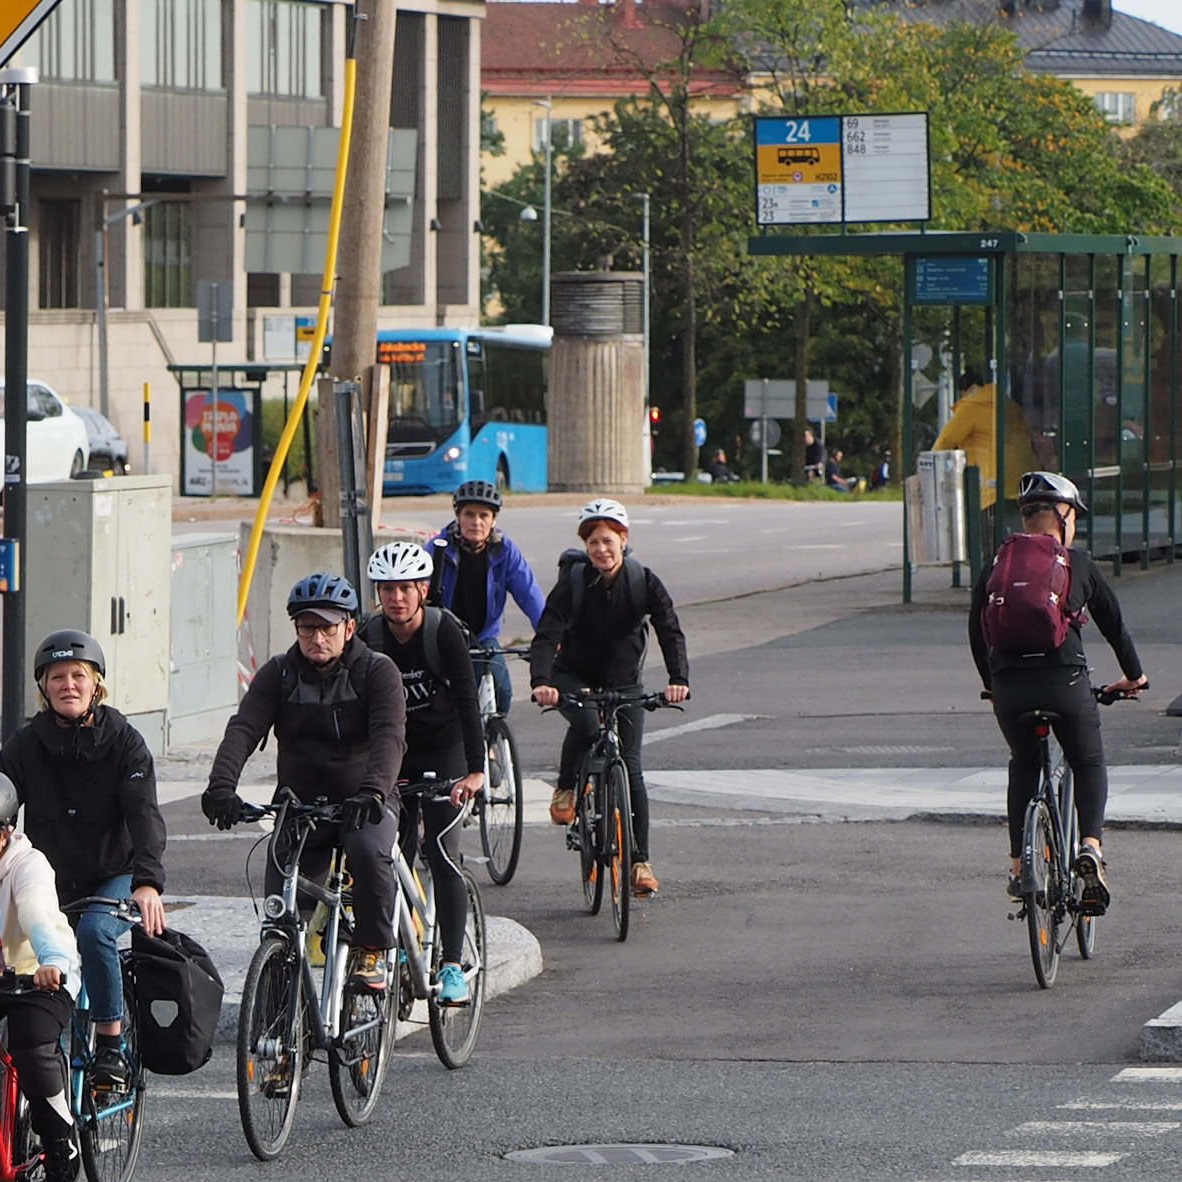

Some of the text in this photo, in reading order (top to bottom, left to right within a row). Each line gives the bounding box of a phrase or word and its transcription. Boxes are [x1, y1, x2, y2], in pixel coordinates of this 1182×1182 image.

[846, 117, 859, 129] 69
[785, 120, 811, 142] 24
[846, 131, 866, 142] 662
[846, 144, 866, 155] 848
[762, 211, 774, 222] 23
[980, 240, 998, 249] 247
